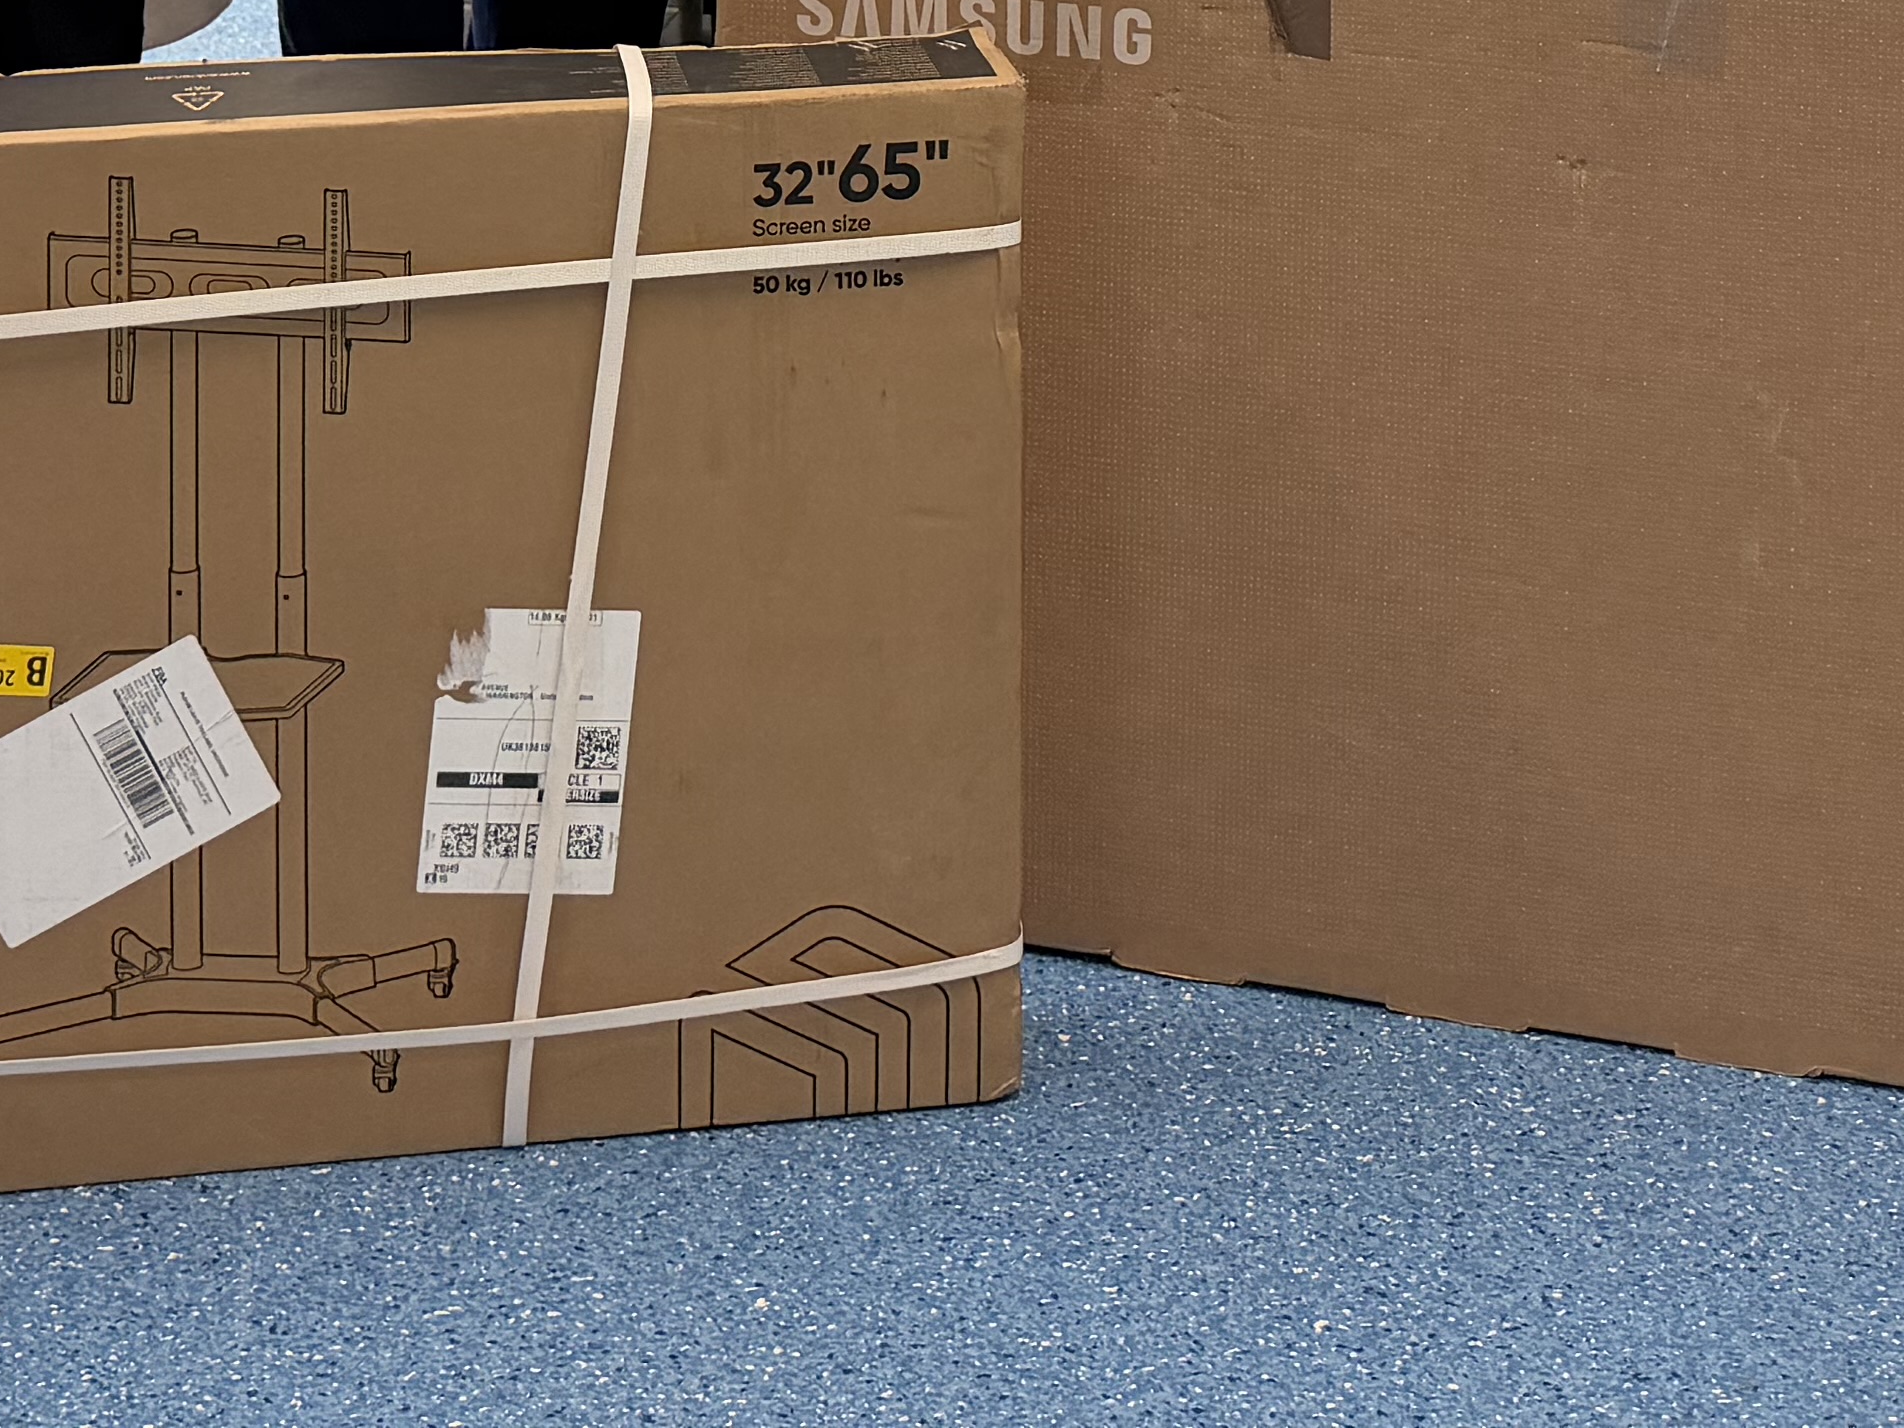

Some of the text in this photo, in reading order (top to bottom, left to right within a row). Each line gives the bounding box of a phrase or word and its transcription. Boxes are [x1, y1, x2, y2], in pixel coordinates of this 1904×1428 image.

[752, 212, 872, 238] Screen size
[752, 268, 904, 297] 50 kg / 110 lbs
[26, 656, 48, 687] B
[567, 773, 590, 787] CLE
[566, 788, 601, 802] ERSIZE
